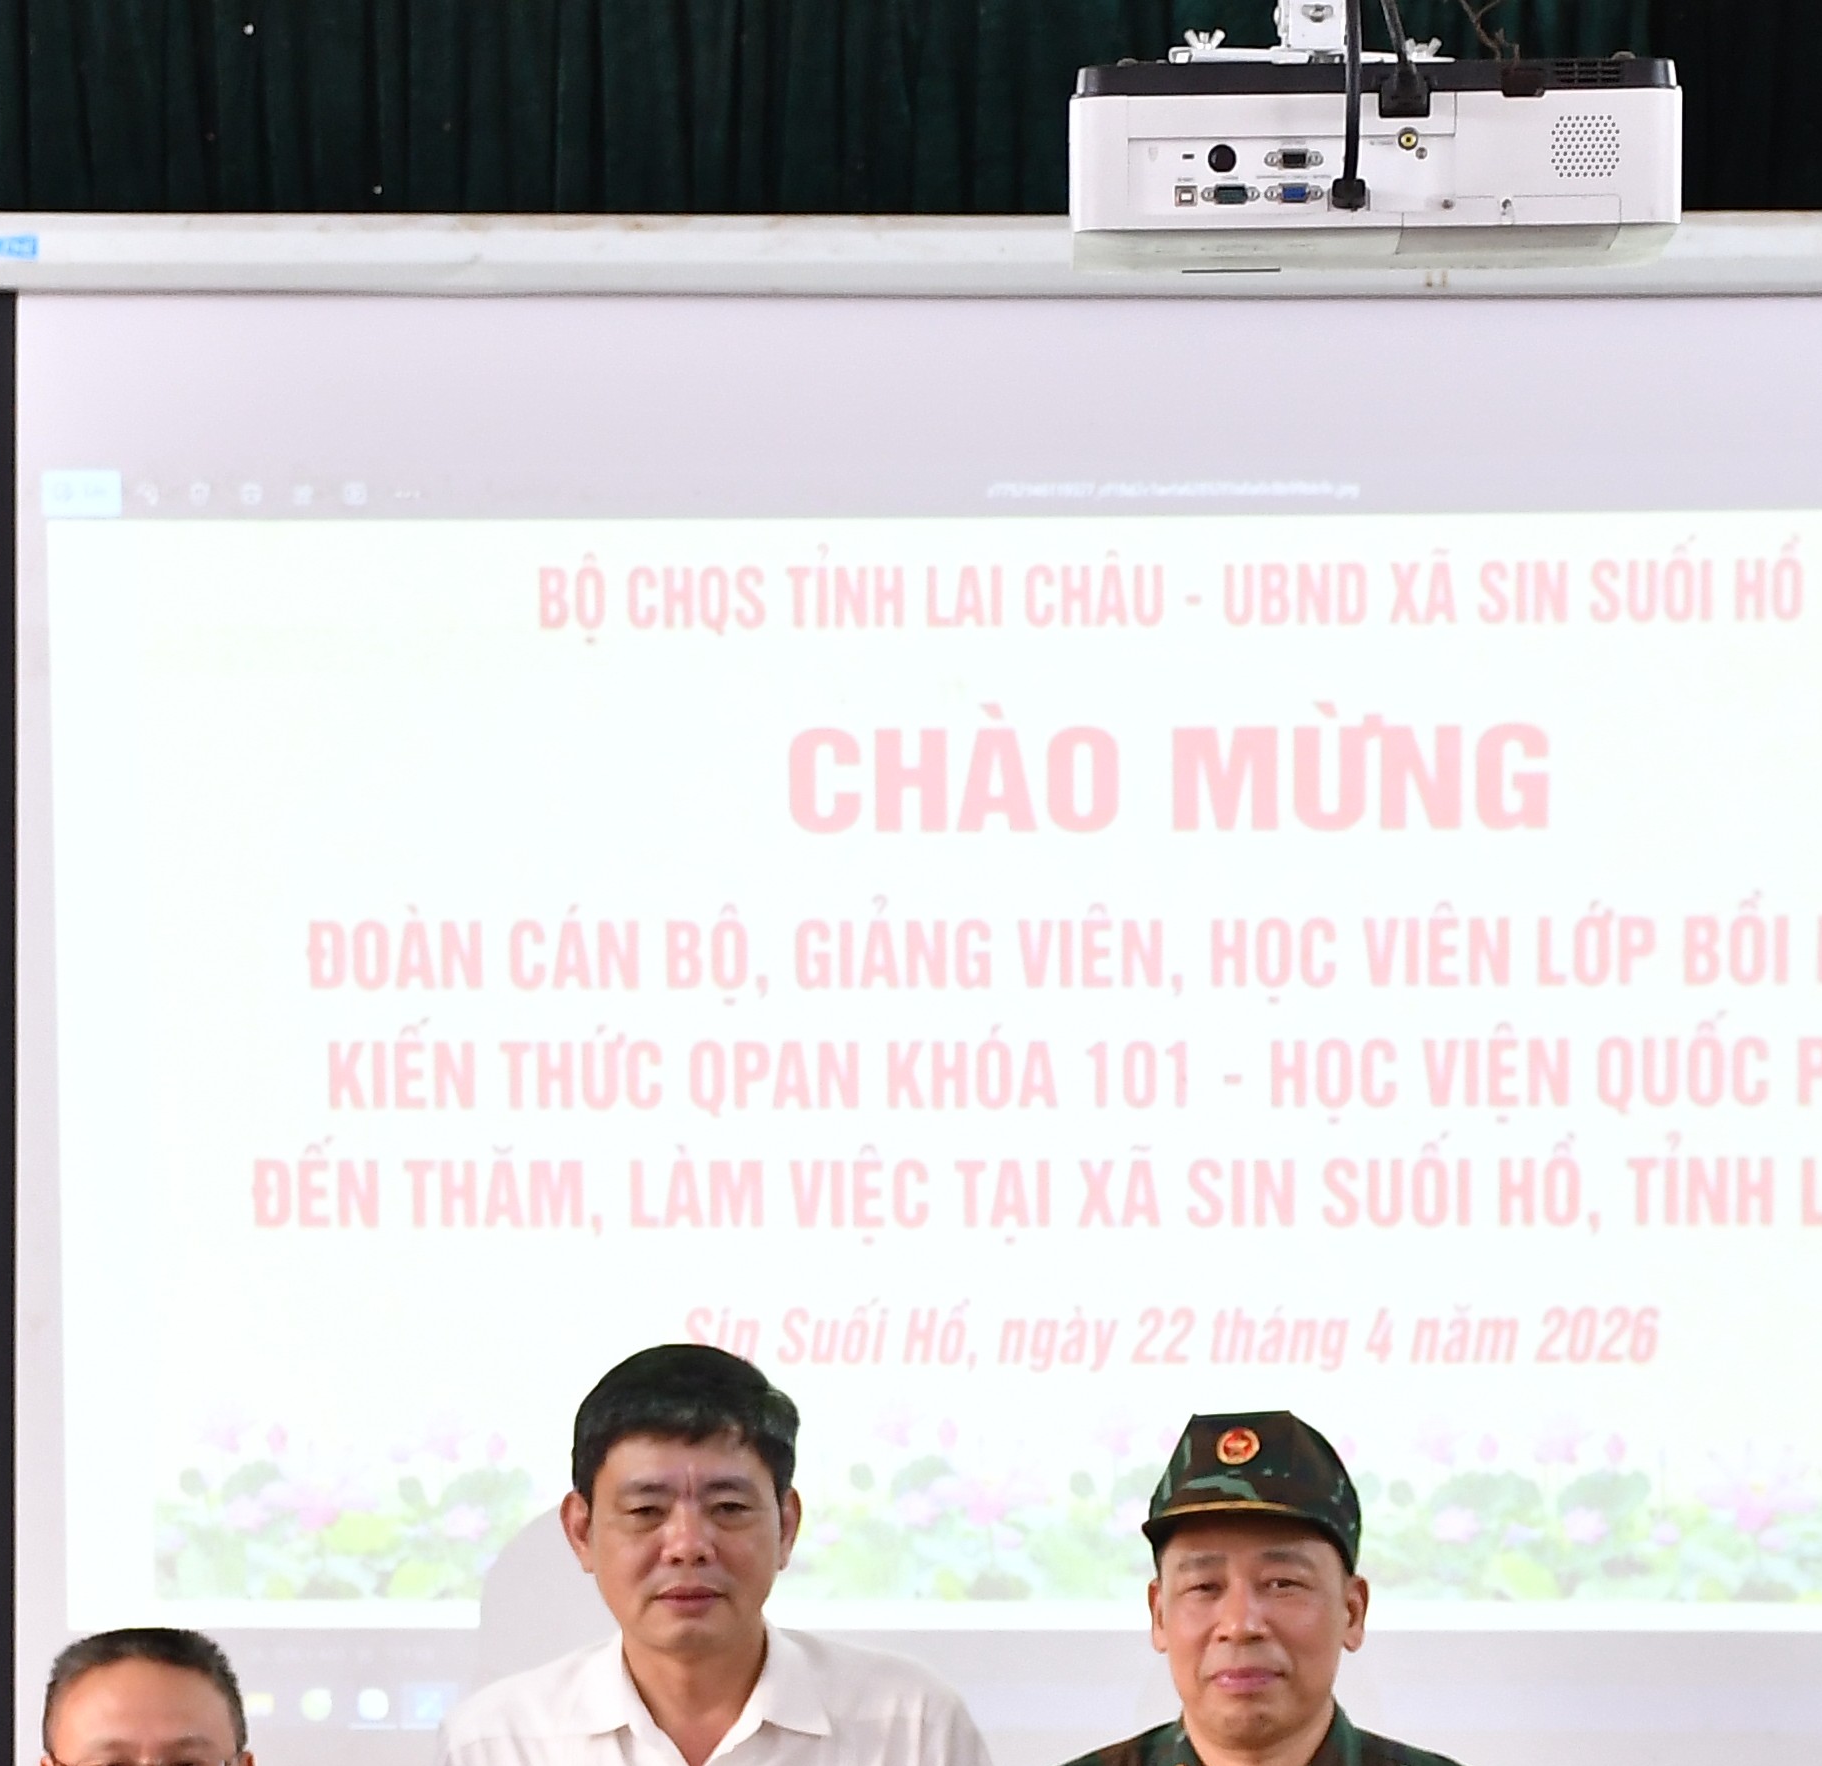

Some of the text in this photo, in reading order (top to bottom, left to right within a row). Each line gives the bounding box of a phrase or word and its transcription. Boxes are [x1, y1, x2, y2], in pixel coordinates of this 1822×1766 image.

[538, 534, 1804, 646] BỘ CHQS TỈNH LAI CHÂU - UBND XÃ SIN SUỐI HỒ
[787, 700, 1551, 835] CHÀO MỪNG
[305, 904, 484, 992] ĐOÀN
[508, 903, 640, 991] CÁN
[664, 902, 769, 1007] BỘ,
[794, 894, 992, 991] GIẢNG
[1017, 902, 1184, 997] VIÊN,
[1210, 916, 1337, 1005] HỌC
[1362, 900, 1511, 988] VIÊN
[1536, 899, 1657, 987] LỚP
[1682, 889, 1790, 987] BỒI
[327, 1017, 476, 1111] KIẾN
[499, 1023, 663, 1111] THỨC
[688, 1038, 860, 1118] QPAN
[886, 1023, 1059, 1111] KHÓA
[1085, 1040, 1189, 1109] 101
[1223, 1073, 1243, 1086] -
[1270, 1037, 1398, 1125] HỌC
[1422, 1021, 1571, 1125] VIỆN
[1596, 1009, 1770, 1116] QUỐC
[251, 1135, 380, 1229] ĐẾN
[402, 1145, 603, 1237] THĂM,
[629, 1143, 764, 1229] LÀM
[789, 1143, 930, 1246] VIỆC
[954, 1158, 1051, 1245] TẠI
[1077, 1144, 1161, 1229] XÃ
[1186, 1157, 1296, 1229] SIN
[1321, 1130, 1472, 1229] SUỐI
[1498, 1131, 1601, 1234] HỒ,
[1626, 1130, 1775, 1227] TỈNH
[684, 1297, 1662, 1373] Sin Suối Hồ, ngày 22 tháng 4 năm 2026
